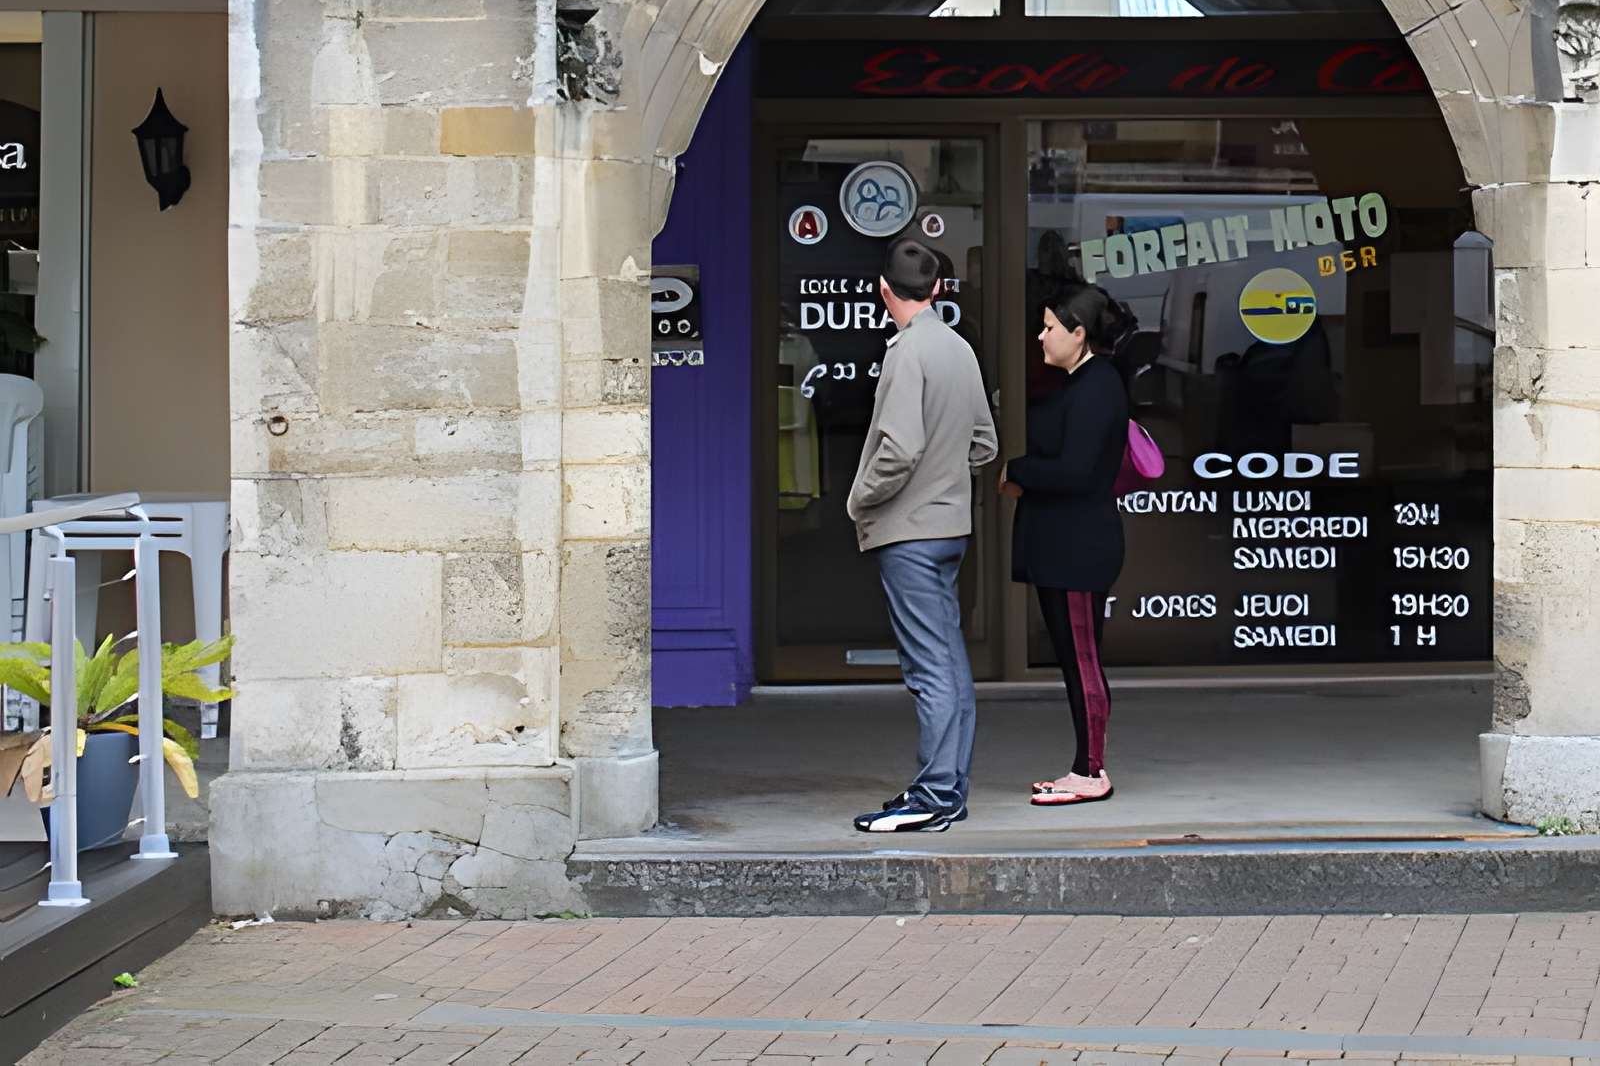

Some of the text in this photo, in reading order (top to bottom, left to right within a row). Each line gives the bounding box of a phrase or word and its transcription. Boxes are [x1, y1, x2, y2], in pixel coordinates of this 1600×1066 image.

[1080, 192, 1388, 284] FORFAIT MOTO
[800, 301, 961, 331] DURAD
[1193, 452, 1360, 479] CODE
[1232, 490, 1312, 513] LUNDI
[1232, 516, 1368, 539] MERCREDI
[1233, 546, 1337, 570] SAMEDI
[1233, 593, 1309, 617] JEUDI
[1233, 624, 1337, 648] SAMEDI
